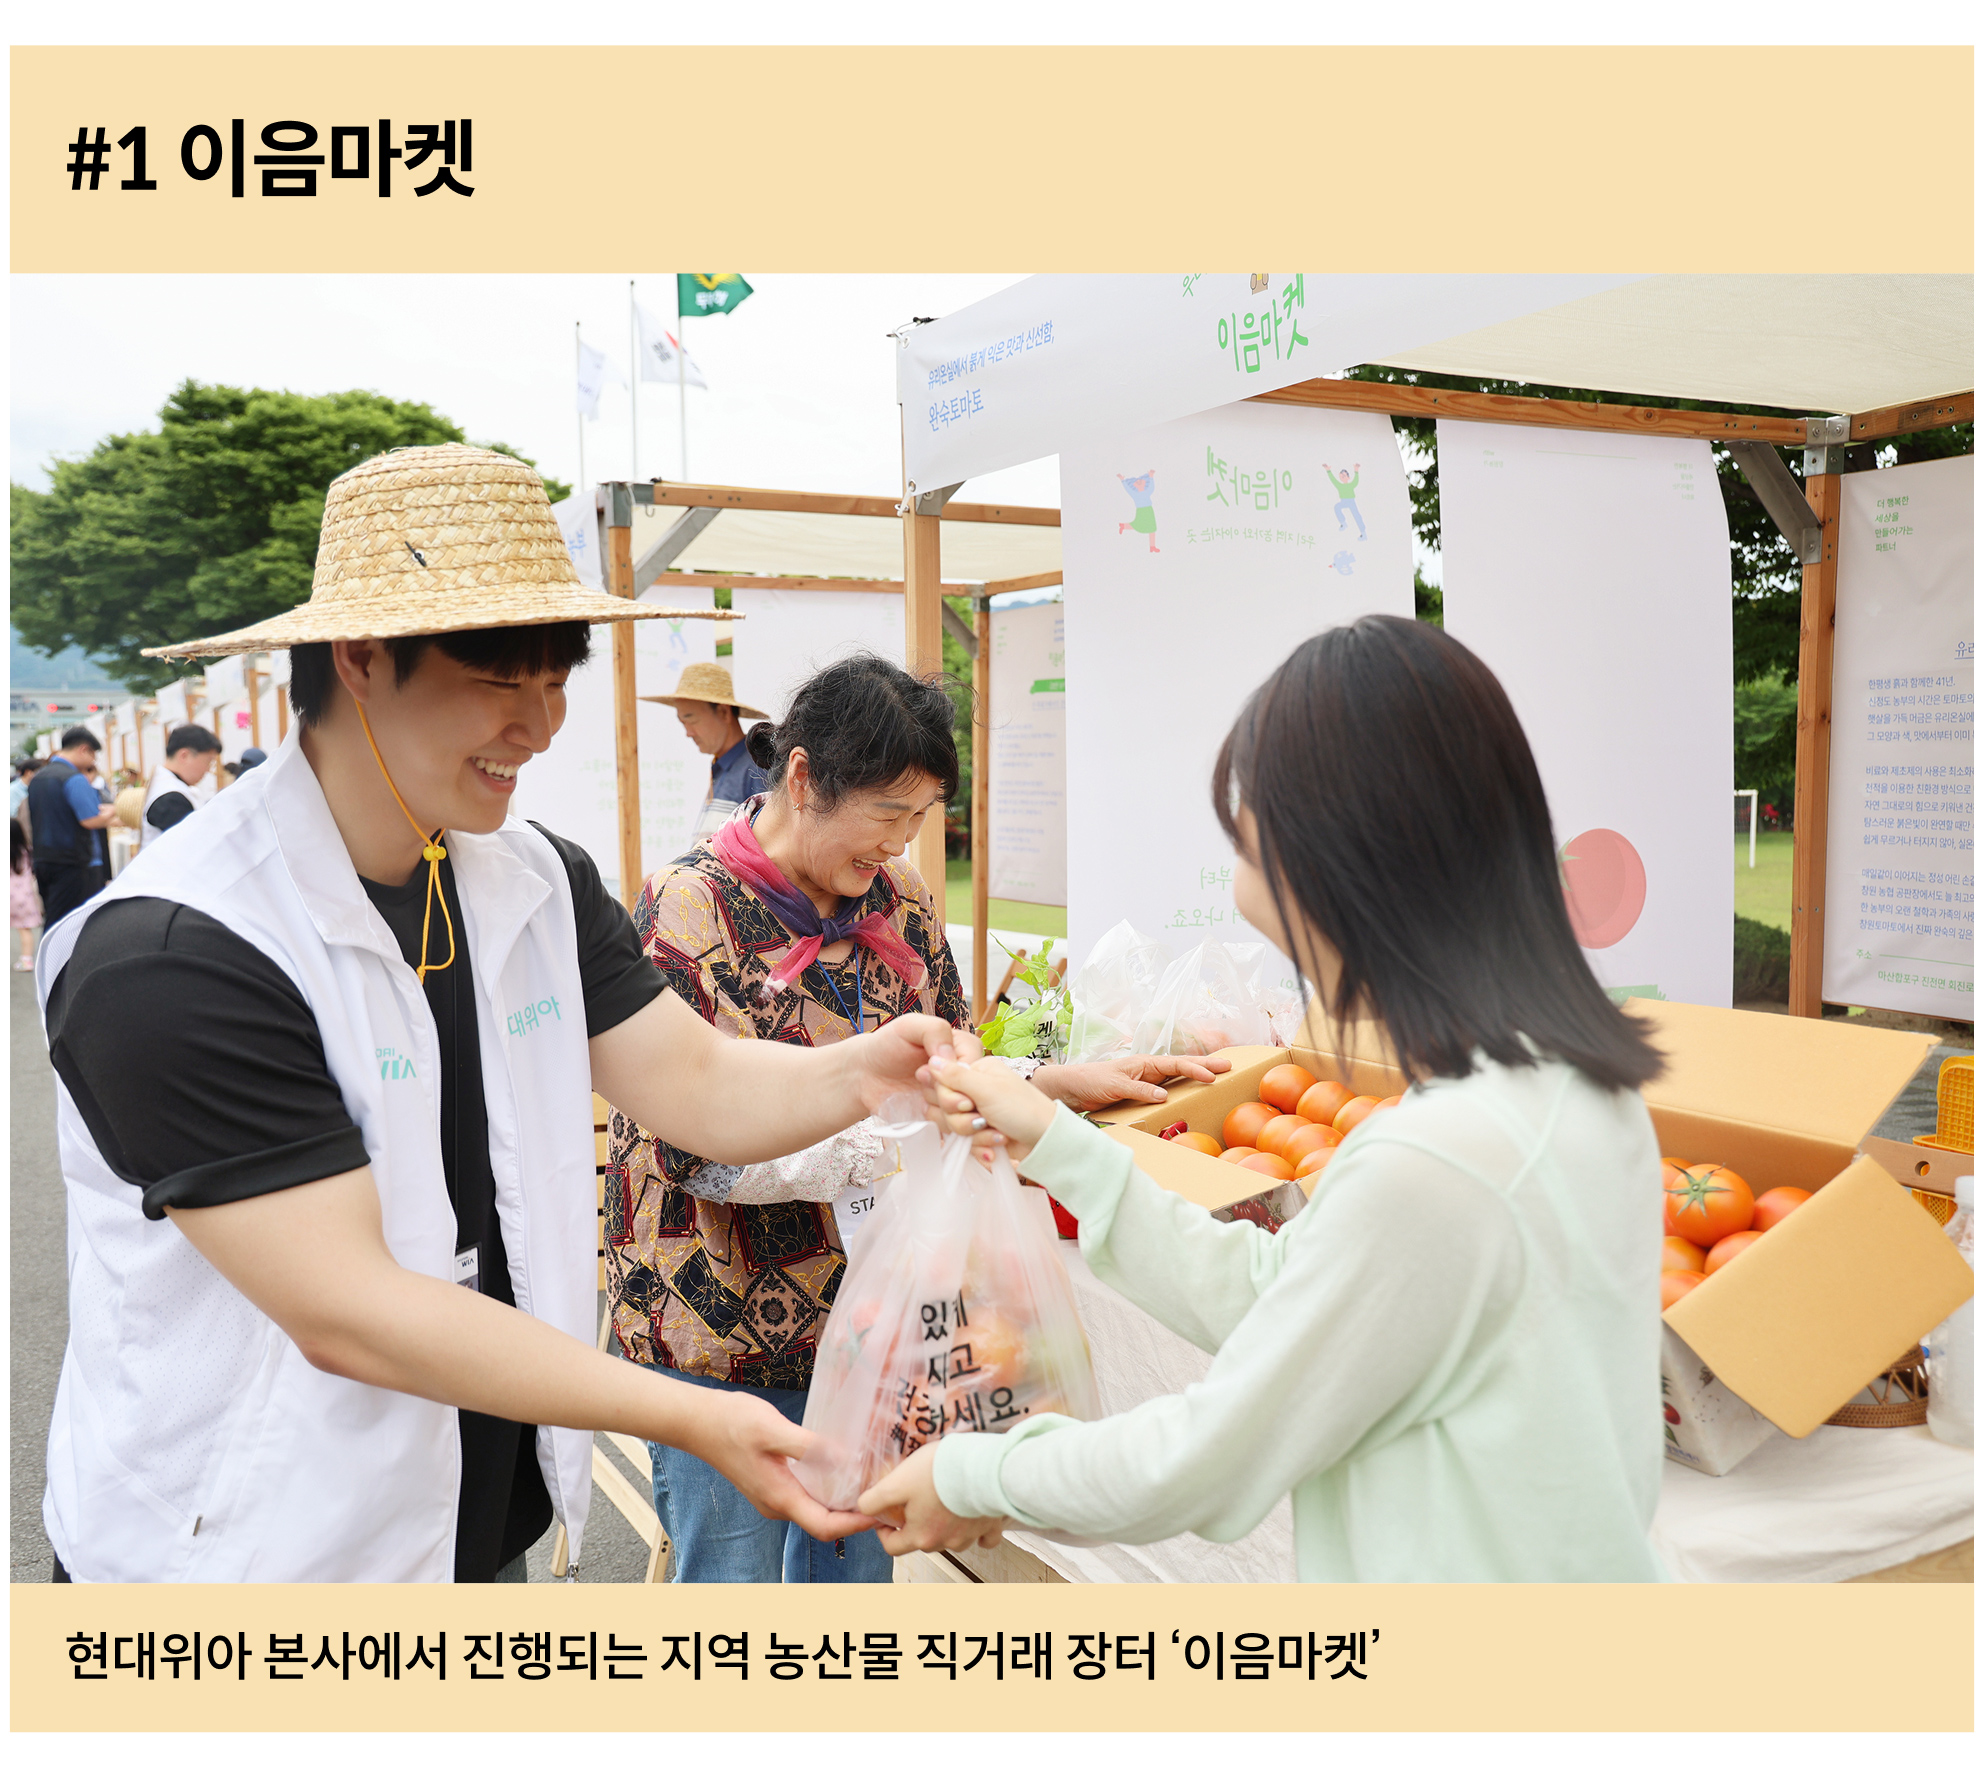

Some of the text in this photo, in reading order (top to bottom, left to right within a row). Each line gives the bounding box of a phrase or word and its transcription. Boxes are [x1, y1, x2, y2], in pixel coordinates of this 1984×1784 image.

[1218, 273, 1308, 373] 이음마켓
[928, 320, 1055, 391] 유리온실에서 붉게 익은 맛과 신선함,
[929, 388, 984, 432] 완숙토마토
[1876, 495, 1909, 509] 더 행복한
[1875, 512, 1899, 523] 세상을
[1875, 525, 1913, 538] 만들어가는
[1875, 541, 1896, 552] 파트너
[1868, 678, 1891, 690] 한평생
[1910, 676, 1934, 689] 함께한
[1936, 675, 1956, 687] 41년.
[1893, 695, 1916, 707] 농부의
[1918, 694, 1941, 706] 시간은
[1868, 713, 1891, 725] 햇살을
[1893, 713, 1908, 724] 가득
[1909, 712, 1933, 724] 머금은
[1877, 731, 1900, 742] 모양과
[1913, 730, 1953, 741] 맛에서부터
[1954, 729, 1971, 741] 이미
[1865, 765, 1889, 776] 비료와
[1890, 765, 1923, 777] 제초제의
[1924, 765, 1947, 777] 사용은
[1865, 782, 1971, 795] 천적을 이용한 친환경 방식으로
[1864, 800, 1880, 811] 자연
[1882, 800, 1913, 811] 그대로의
[1915, 800, 1939, 812] 힘으로
[1940, 802, 1964, 813] 키워낸
[1863, 834, 1879, 845] 쉽게
[1880, 834, 1912, 846] 무르거나
[1913, 836, 1937, 848] 터지지
[1958, 839, 1974, 850] 실온
[1894, 869, 1926, 883] 이어지는
[1928, 872, 1944, 884] 정성
[1945, 873, 1960, 886] 어린
[1860, 902, 1869, 913] 한
[1870, 903, 1893, 915] 농부의
[1915, 923, 1932, 936] 진짜
[1934, 925, 1956, 938] 완숙의
[1856, 948, 1872, 960] 주소
[1878, 970, 1919, 986] 마산합포구
[1921, 976, 1946, 990] 진전면
[507, 996, 562, 1038] 대위아
